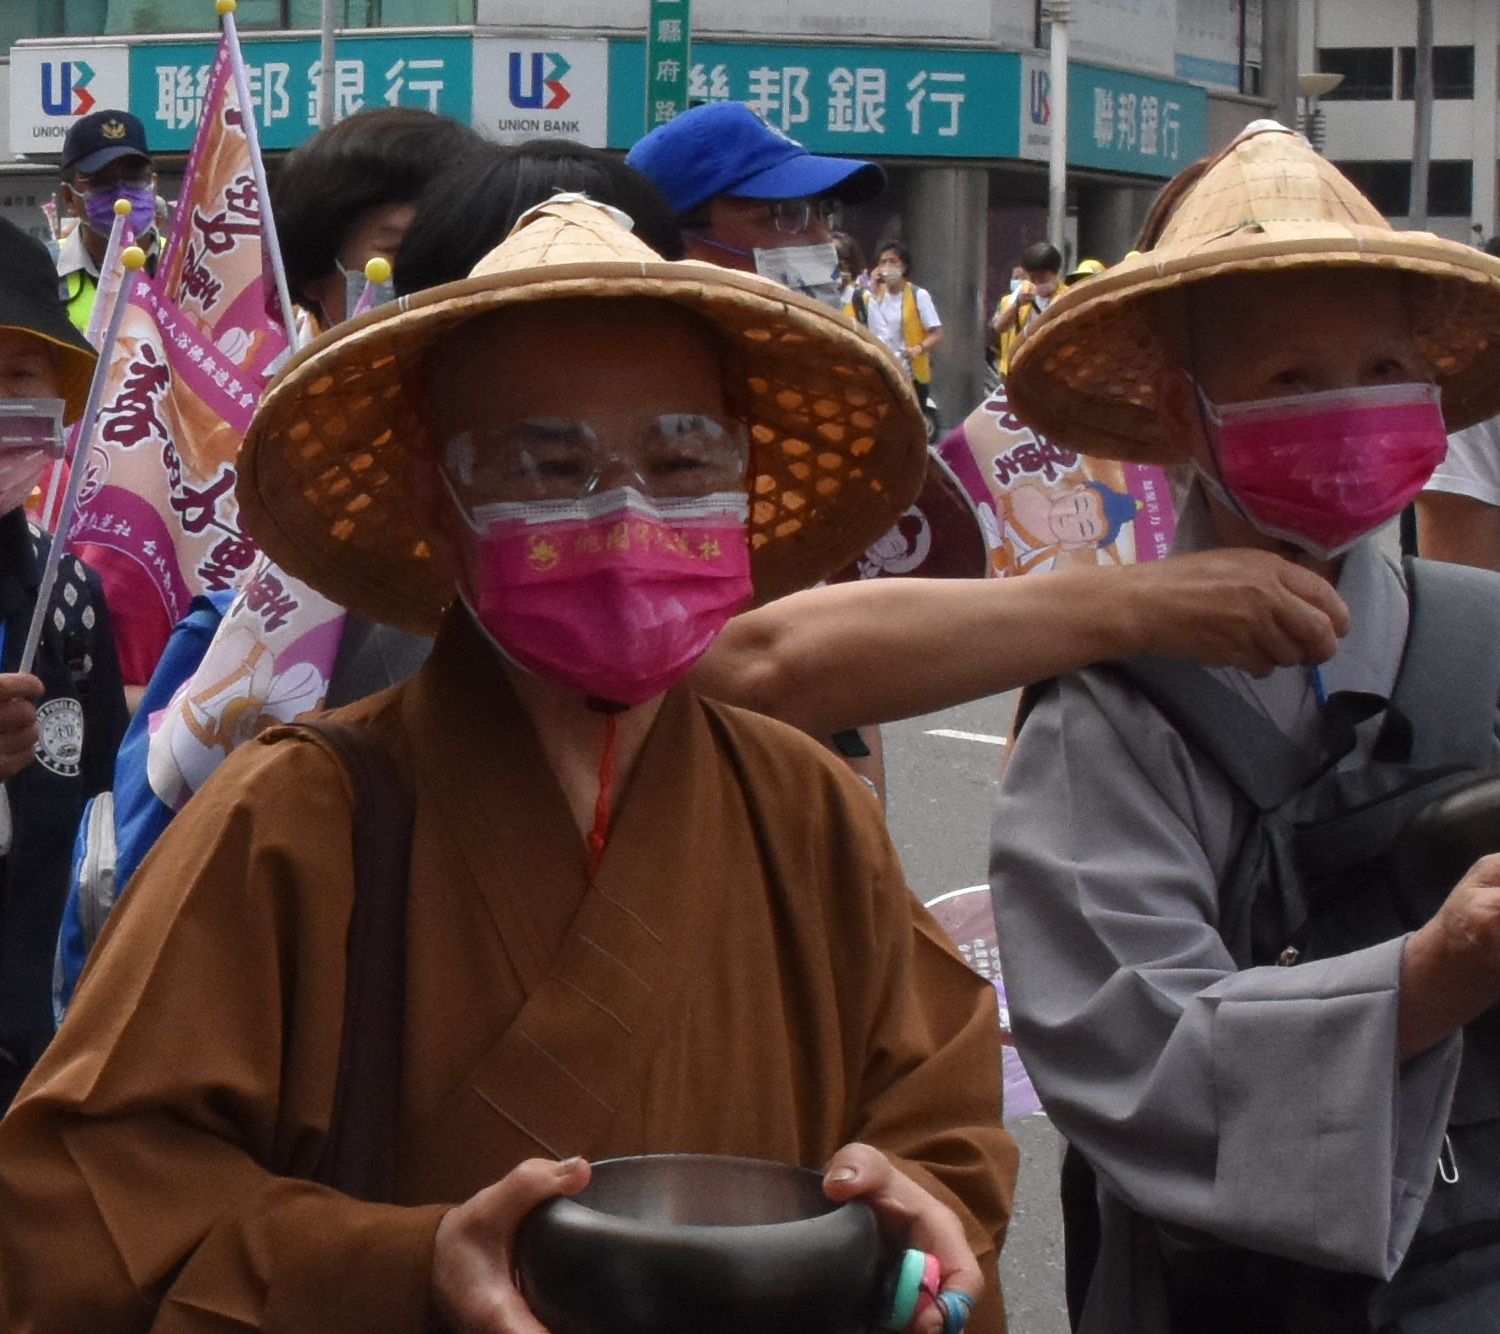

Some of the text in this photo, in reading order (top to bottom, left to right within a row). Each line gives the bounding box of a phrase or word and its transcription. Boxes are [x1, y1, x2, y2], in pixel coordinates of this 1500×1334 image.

[655, 18, 682, 123] 縣府路
[32, 127, 67, 139] UNION
[499, 120, 581, 134] UNION BANK
[1093, 86, 1181, 160] 聯邦銀行
